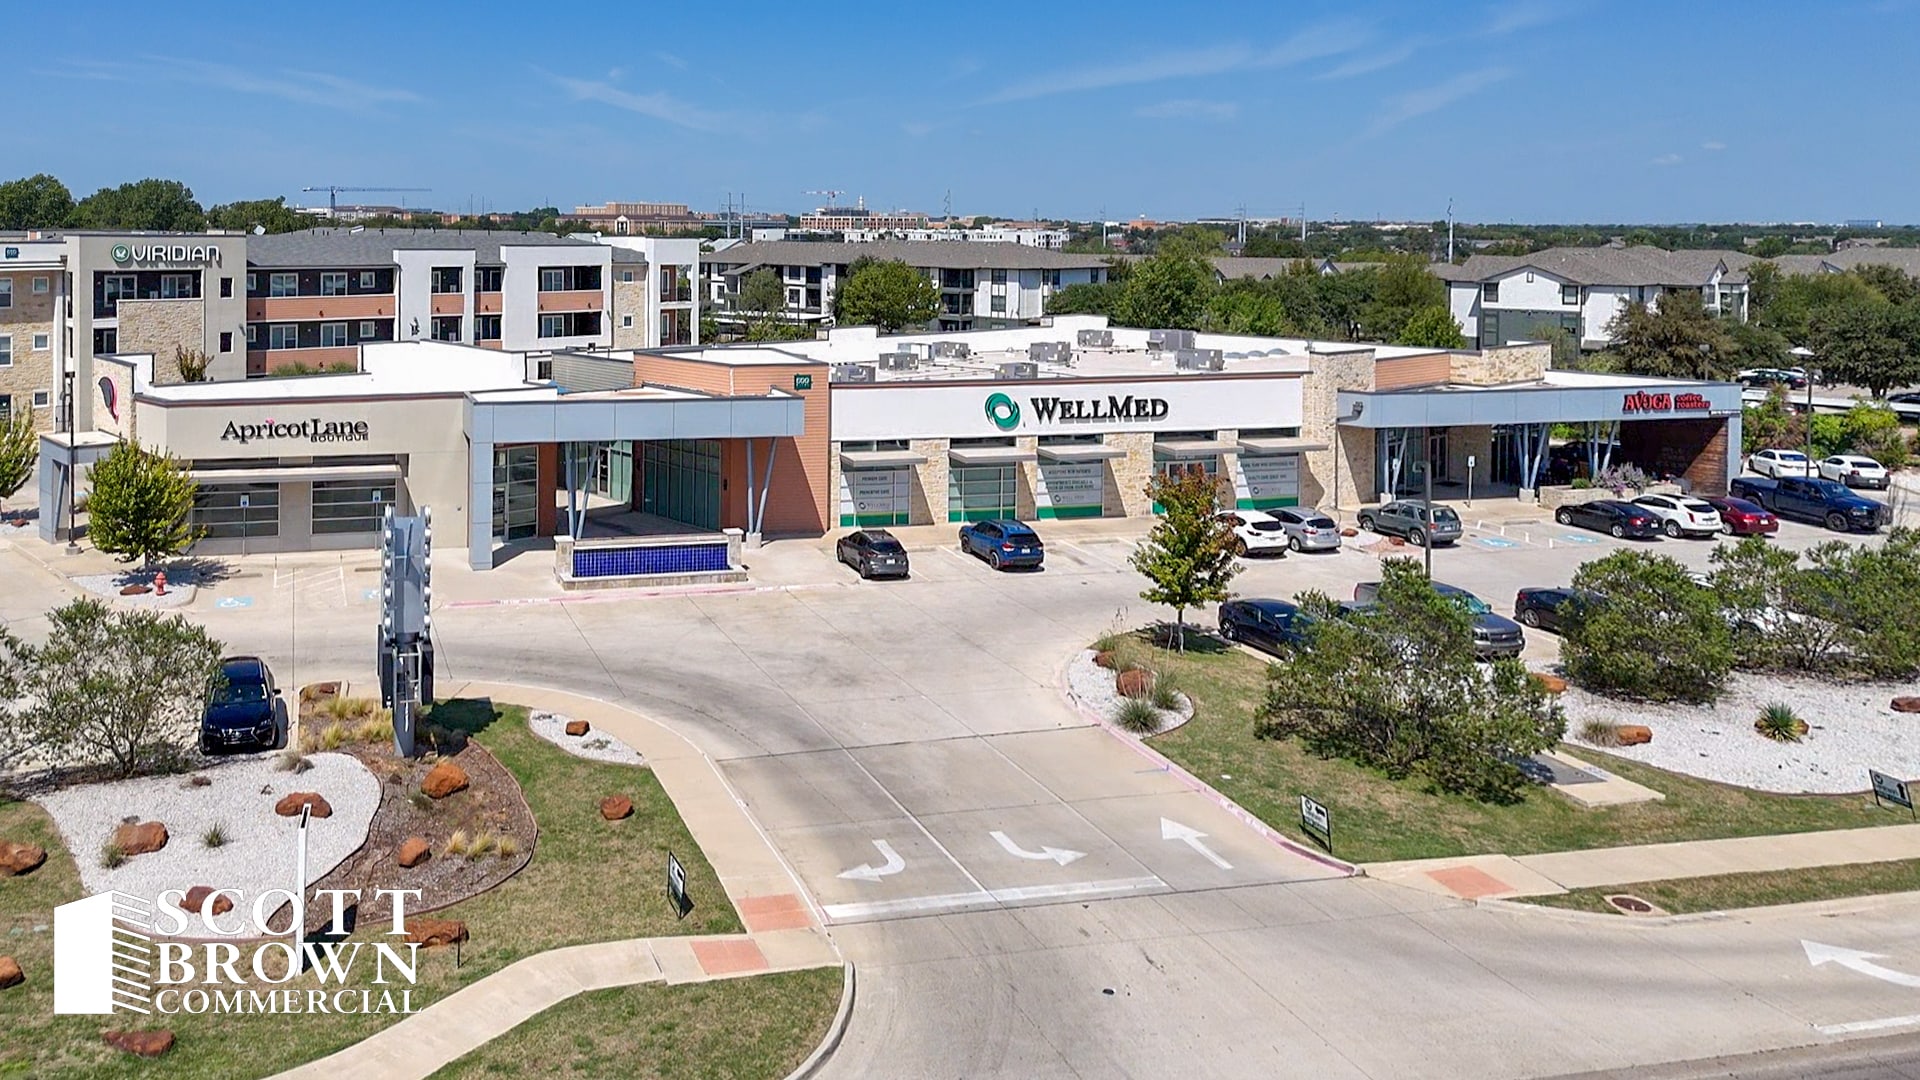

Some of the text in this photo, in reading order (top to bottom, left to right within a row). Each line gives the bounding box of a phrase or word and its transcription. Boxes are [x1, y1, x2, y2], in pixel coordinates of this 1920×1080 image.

[131, 245, 220, 262] VIRIDIAN
[1623, 391, 1672, 411] AVOCA
[220, 417, 369, 444] Apricot Lane
[310, 433, 369, 443] BOUTIQUE
